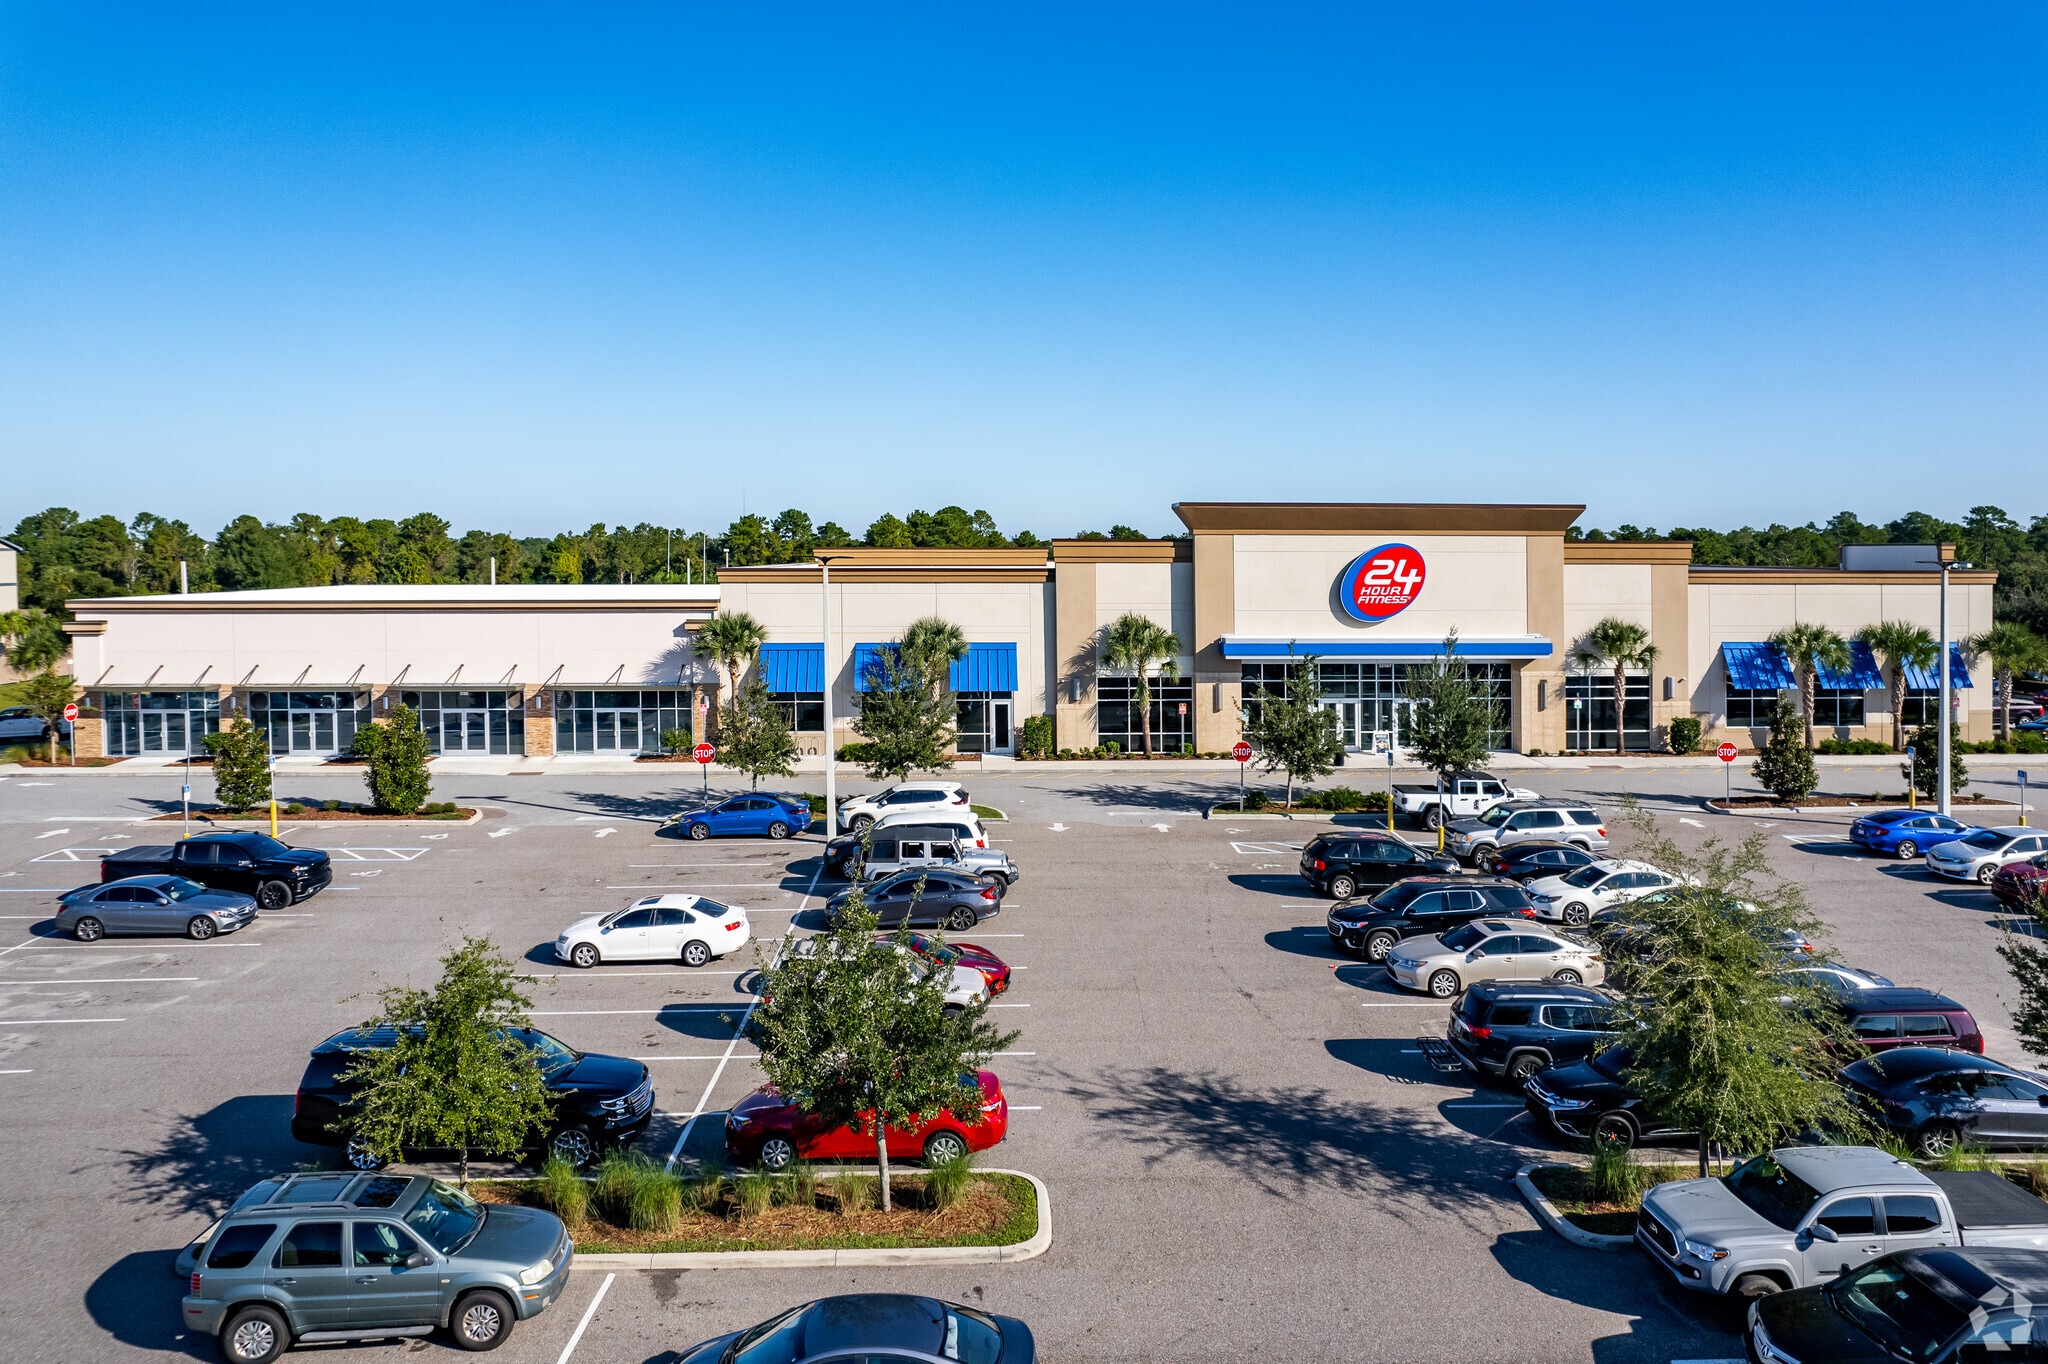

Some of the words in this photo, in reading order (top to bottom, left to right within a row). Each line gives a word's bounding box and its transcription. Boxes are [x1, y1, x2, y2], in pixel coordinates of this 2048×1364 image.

[1363, 559, 1422, 595] 24
[1360, 586, 1401, 595] HOUR
[1357, 596, 1408, 604] FITNESS
[694, 749, 714, 758] STOP
[1233, 748, 1251, 756] STOP
[1719, 748, 1737, 757] STOP
